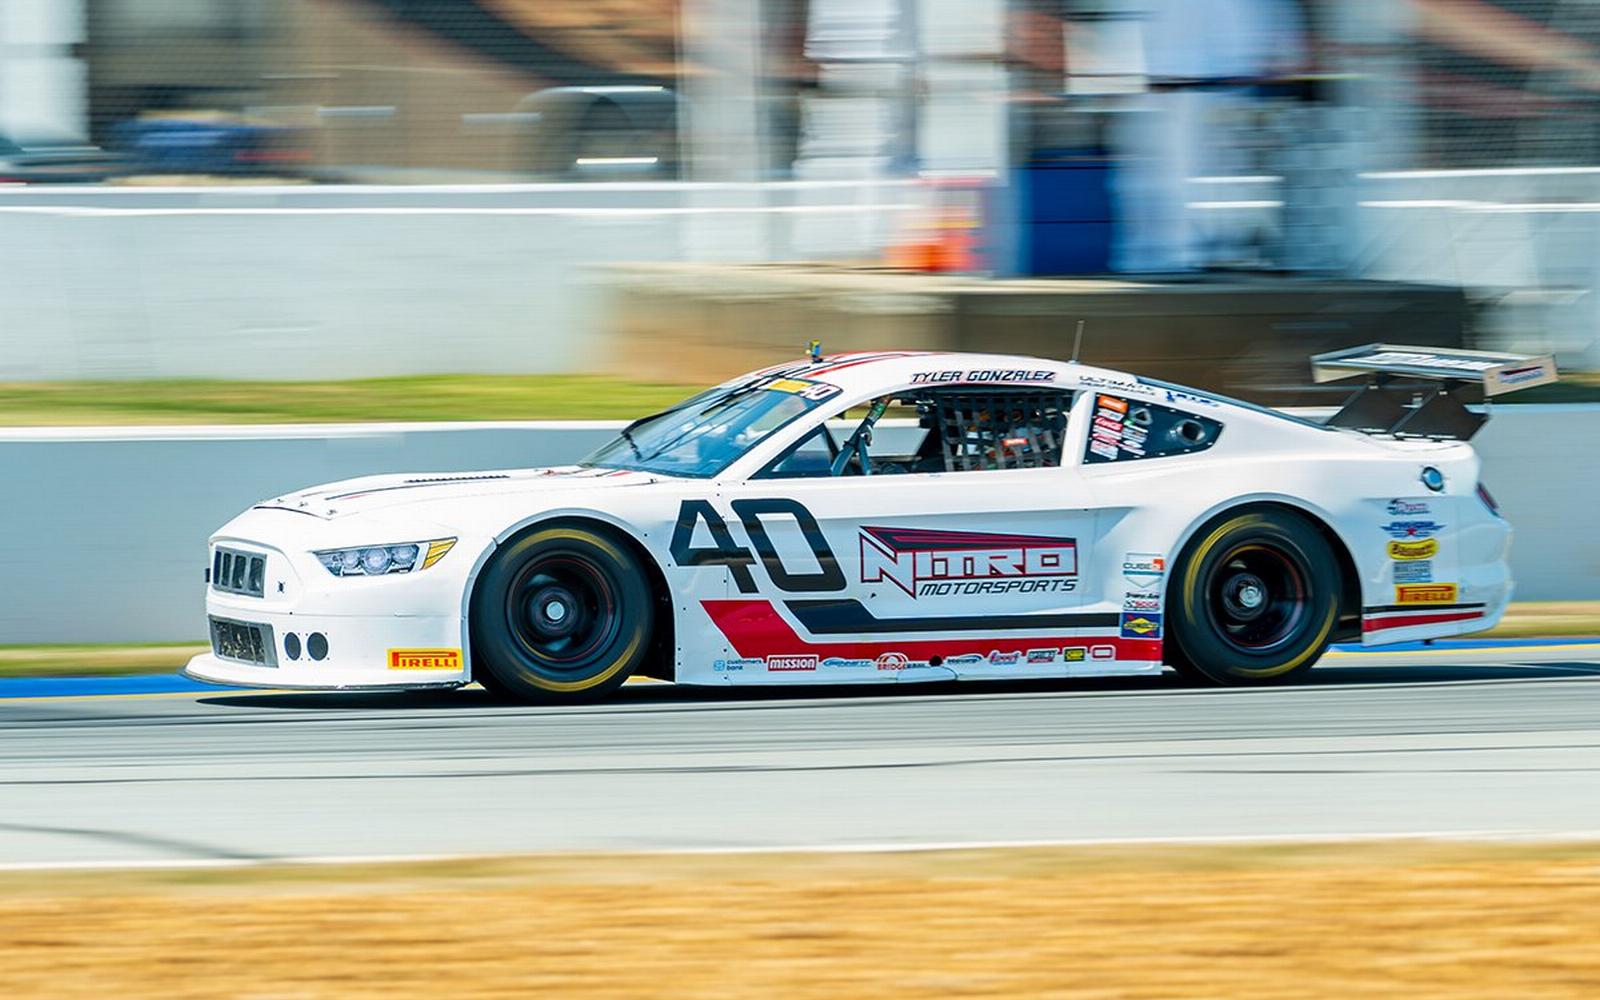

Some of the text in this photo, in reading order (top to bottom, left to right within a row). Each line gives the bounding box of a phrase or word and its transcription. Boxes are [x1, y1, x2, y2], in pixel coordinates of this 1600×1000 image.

[911, 370, 1057, 383] TYLER GONZALEZ
[669, 498, 847, 594] 40
[918, 578, 1078, 596] MOTORSPORTS
[392, 651, 458, 667] PIRELLI
[768, 658, 816, 669] mission
